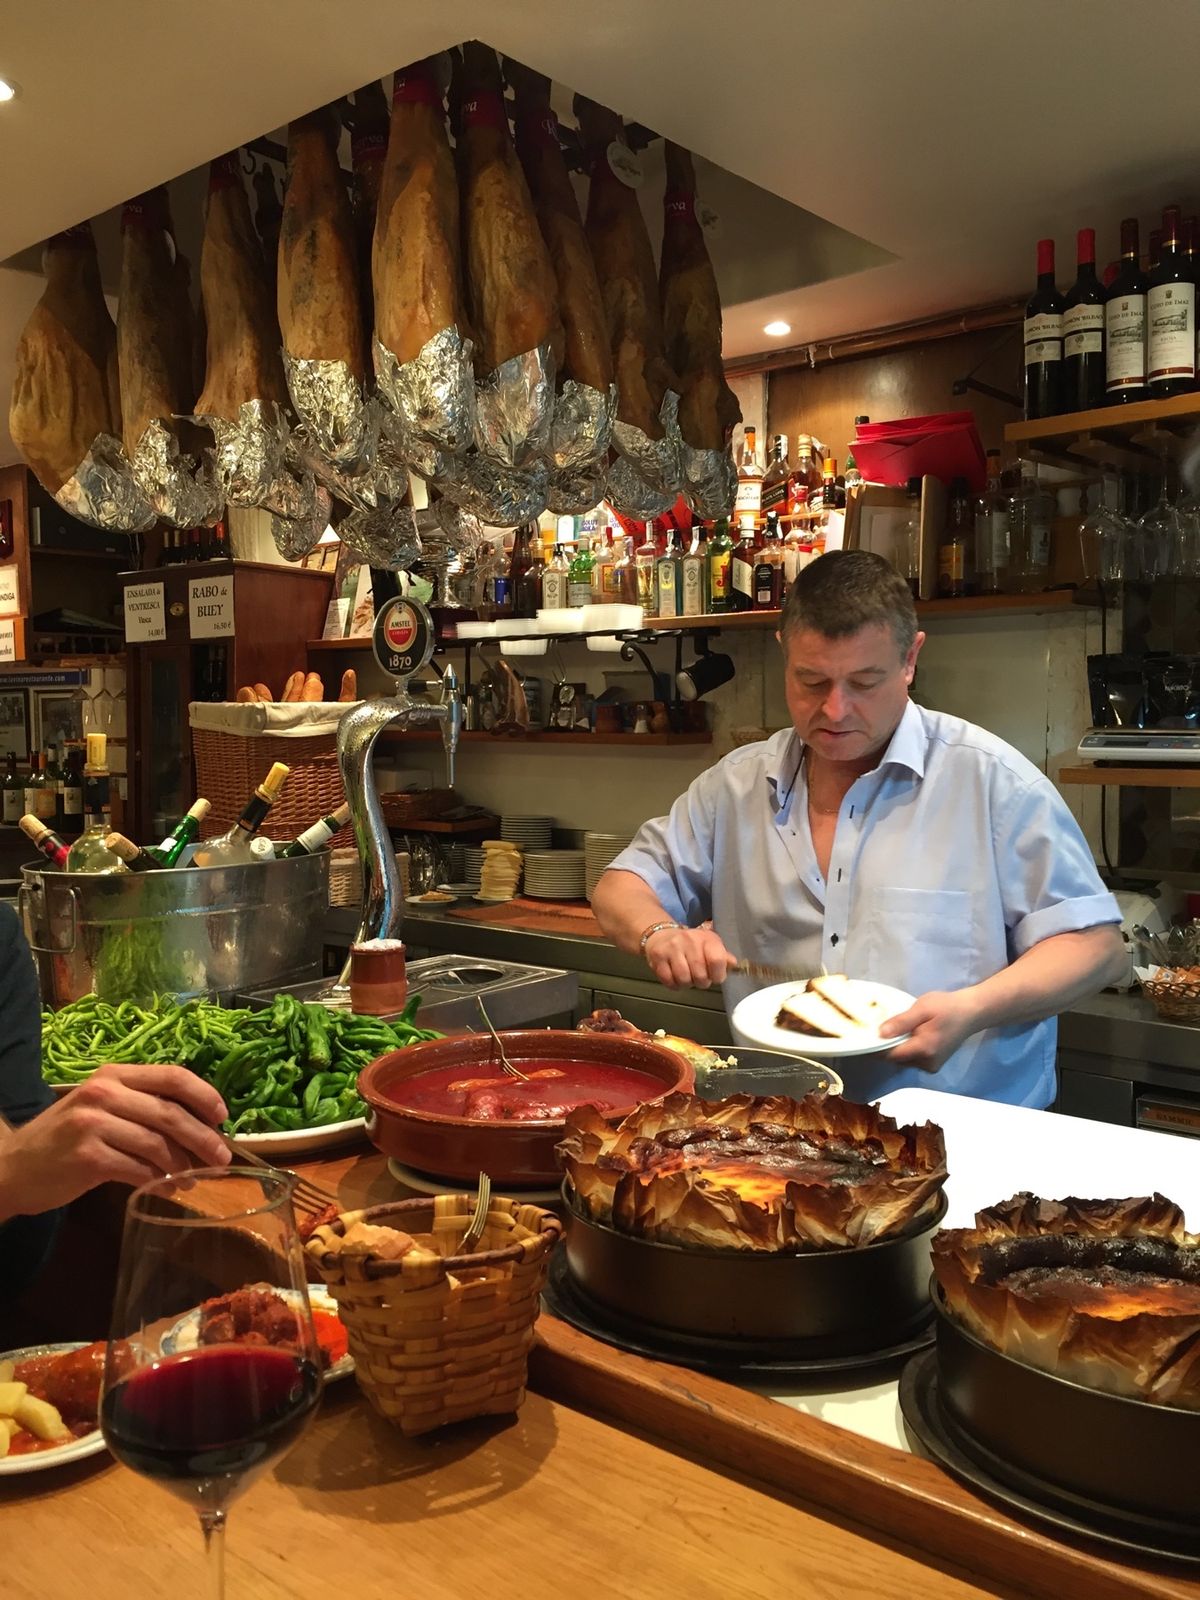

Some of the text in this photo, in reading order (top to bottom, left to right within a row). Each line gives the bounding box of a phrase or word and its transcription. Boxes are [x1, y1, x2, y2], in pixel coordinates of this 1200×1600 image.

[127, 589, 157, 598] ENSALADA
[192, 585, 228, 599] RABO de
[128, 602, 160, 611] VENTRESCA
[197, 604, 224, 617] BUEY
[388, 654, 412, 669] 1870
